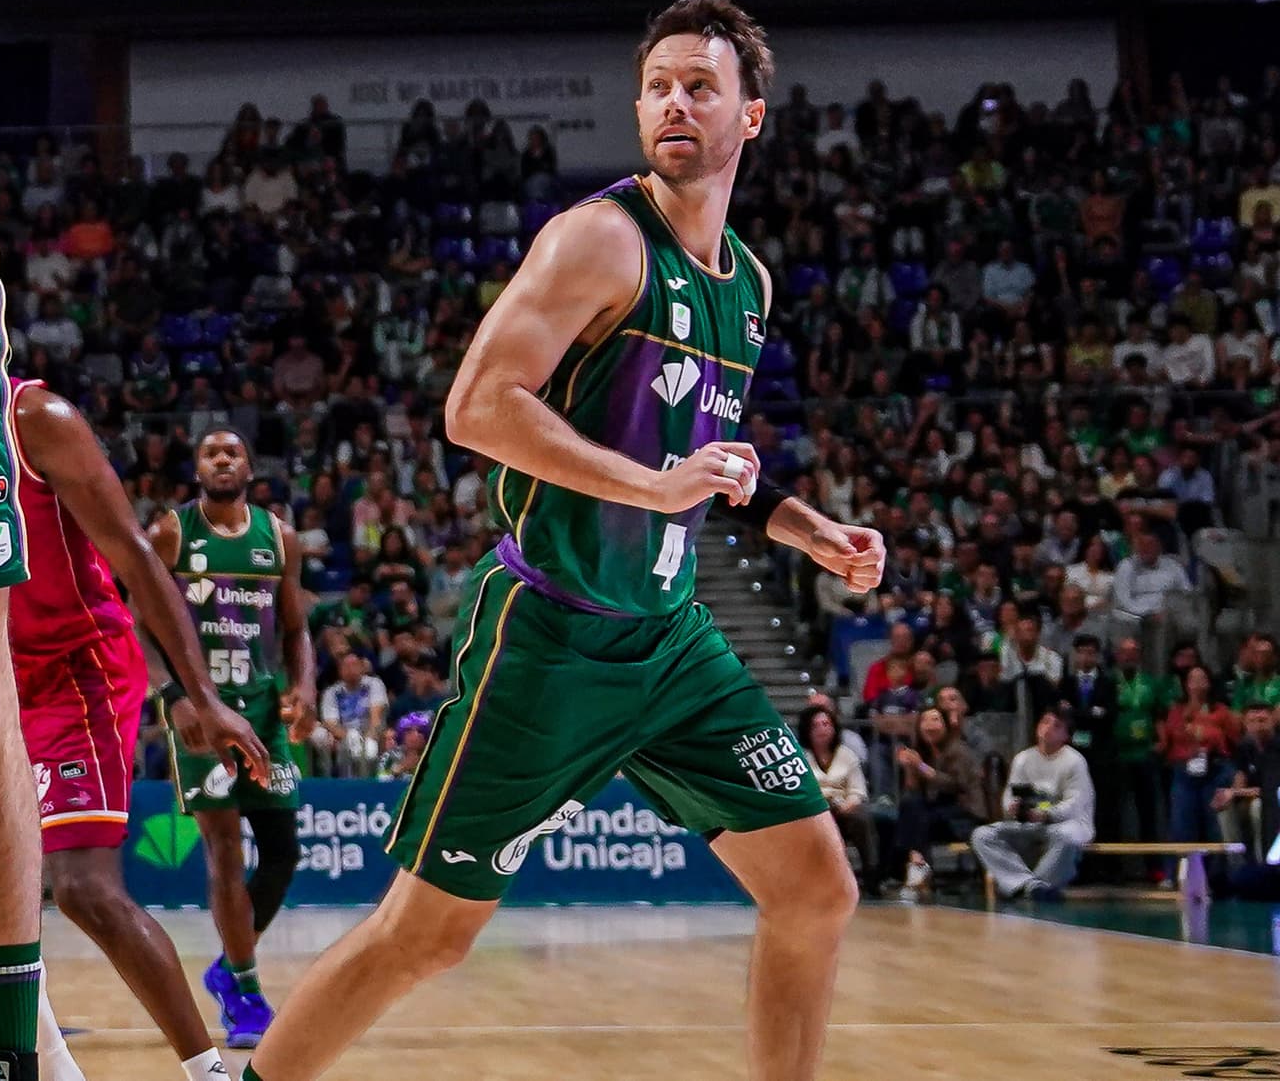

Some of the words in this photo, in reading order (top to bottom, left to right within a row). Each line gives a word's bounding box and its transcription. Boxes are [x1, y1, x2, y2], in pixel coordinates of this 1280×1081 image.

[700, 382, 743, 424] Unic
[216, 587, 274, 610] Unicaja
[208, 649, 251, 685] 55
[543, 835, 687, 880] Unicaja
